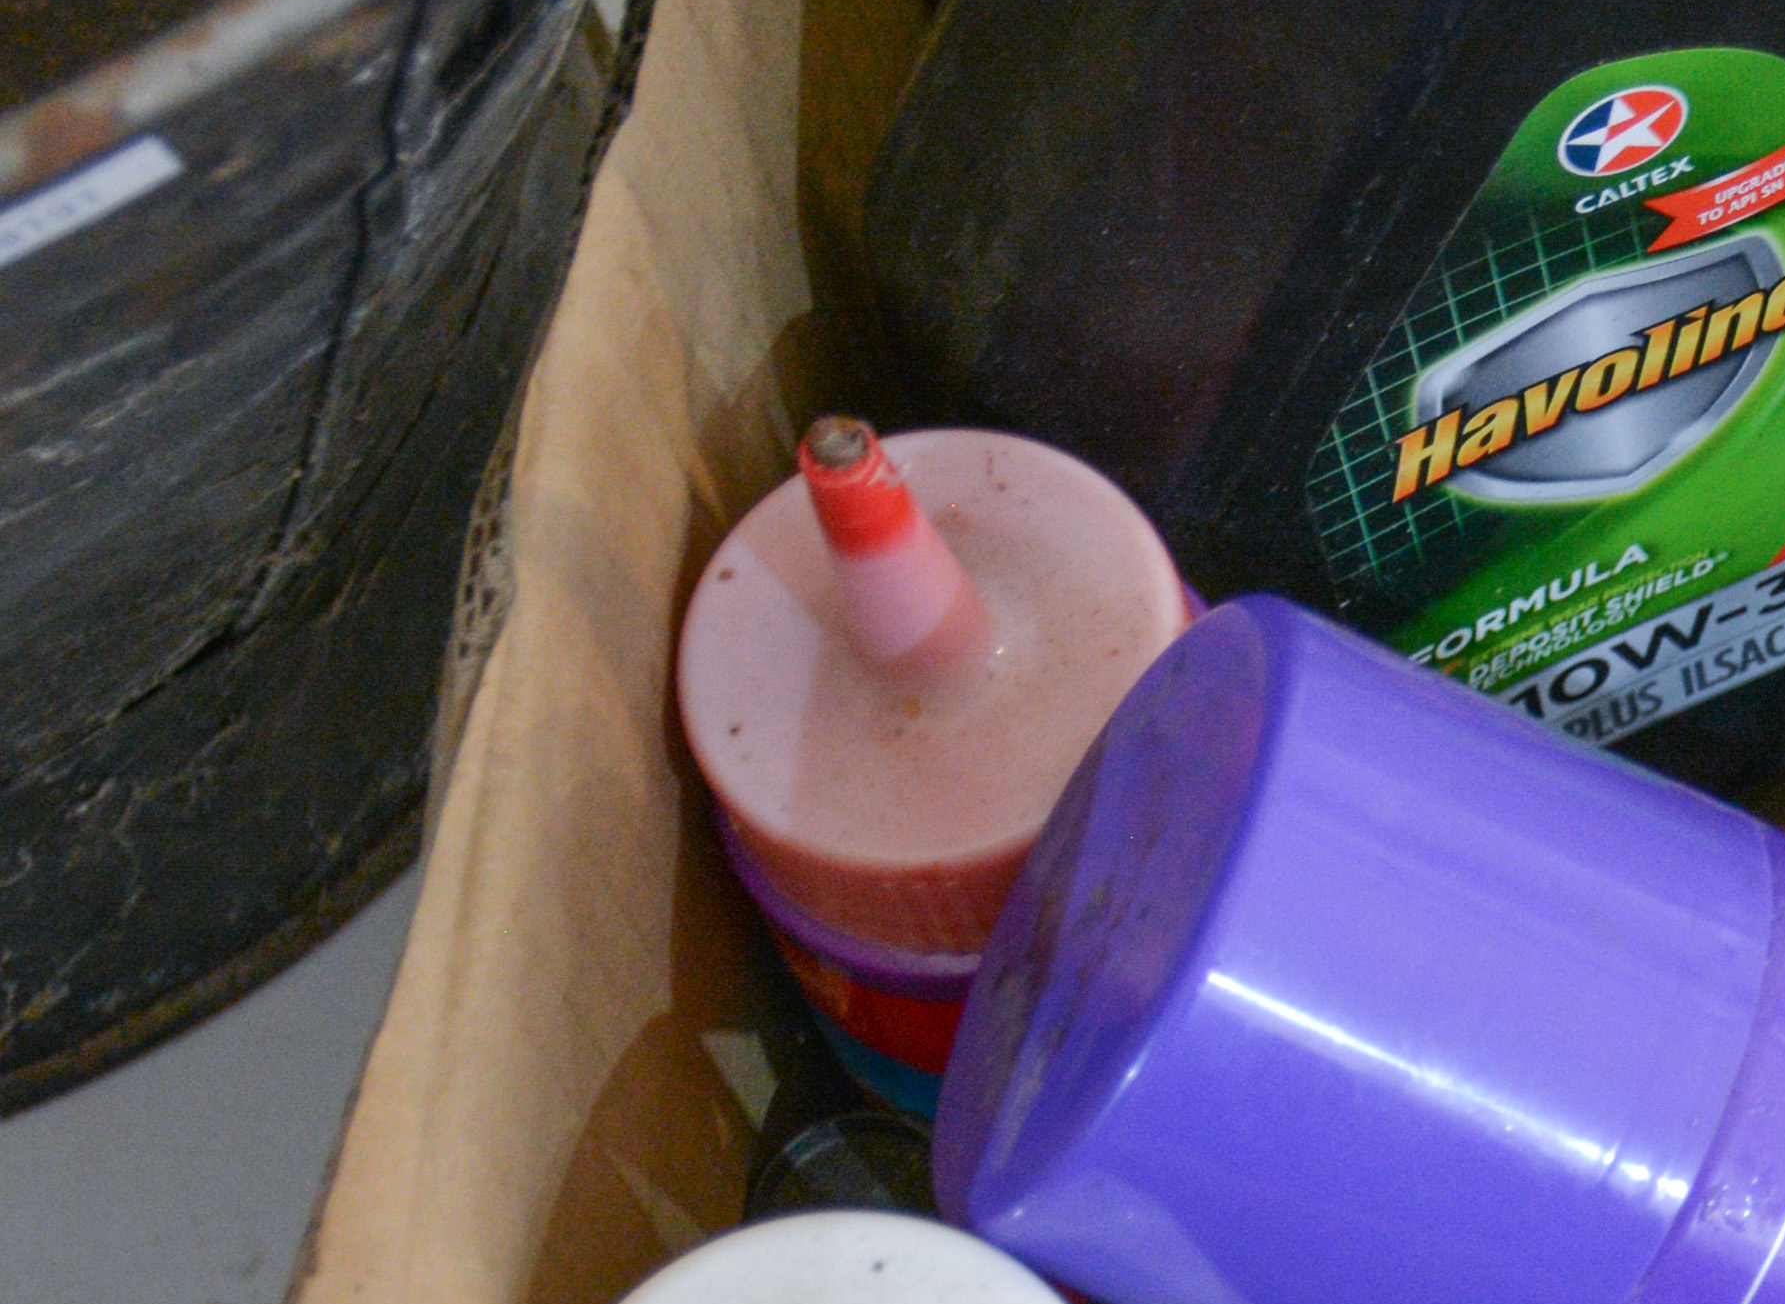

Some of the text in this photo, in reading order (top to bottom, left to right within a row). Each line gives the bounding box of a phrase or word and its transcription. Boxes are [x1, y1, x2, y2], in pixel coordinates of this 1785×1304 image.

[1575, 155, 1695, 214] CALTEX
[1697, 206, 1724, 225] TO
[1728, 192, 1757, 214] API
[1761, 178, 1784, 198] SN
[1408, 543, 1649, 665] FORMULA
[1469, 612, 1597, 685] DEPOSIT
[1562, 677, 1664, 741] PLUS
